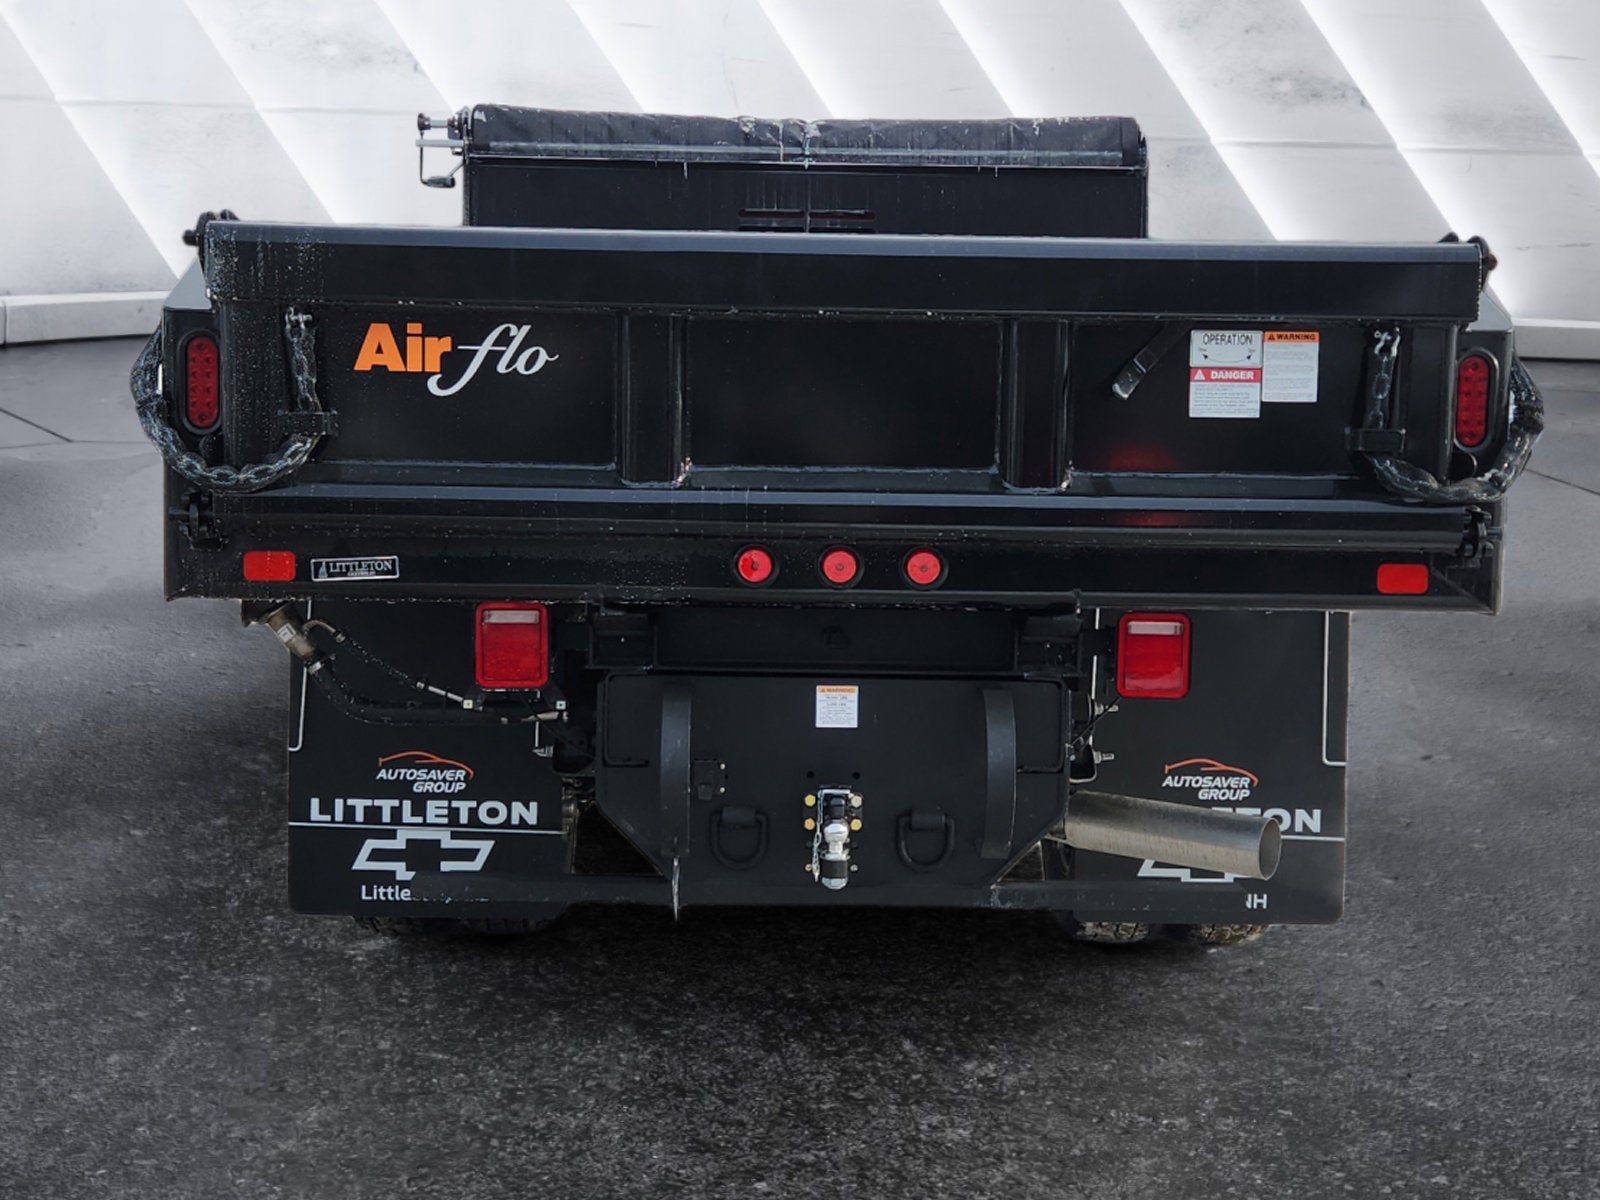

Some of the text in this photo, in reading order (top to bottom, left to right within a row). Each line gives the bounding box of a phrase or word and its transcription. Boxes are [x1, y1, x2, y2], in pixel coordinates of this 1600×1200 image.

[1202, 333, 1253, 345] OPERATION
[1276, 333, 1317, 341] WARNING
[1210, 370, 1255, 380] DANGER
[329, 560, 393, 573] LITTLETON
[376, 768, 467, 781] AUTOSAVER
[412, 781, 467, 794] GROUP
[1162, 775, 1250, 789] AUTOSAVER
[1198, 788, 1250, 801] GROUP
[310, 797, 538, 826] LITTLETON
